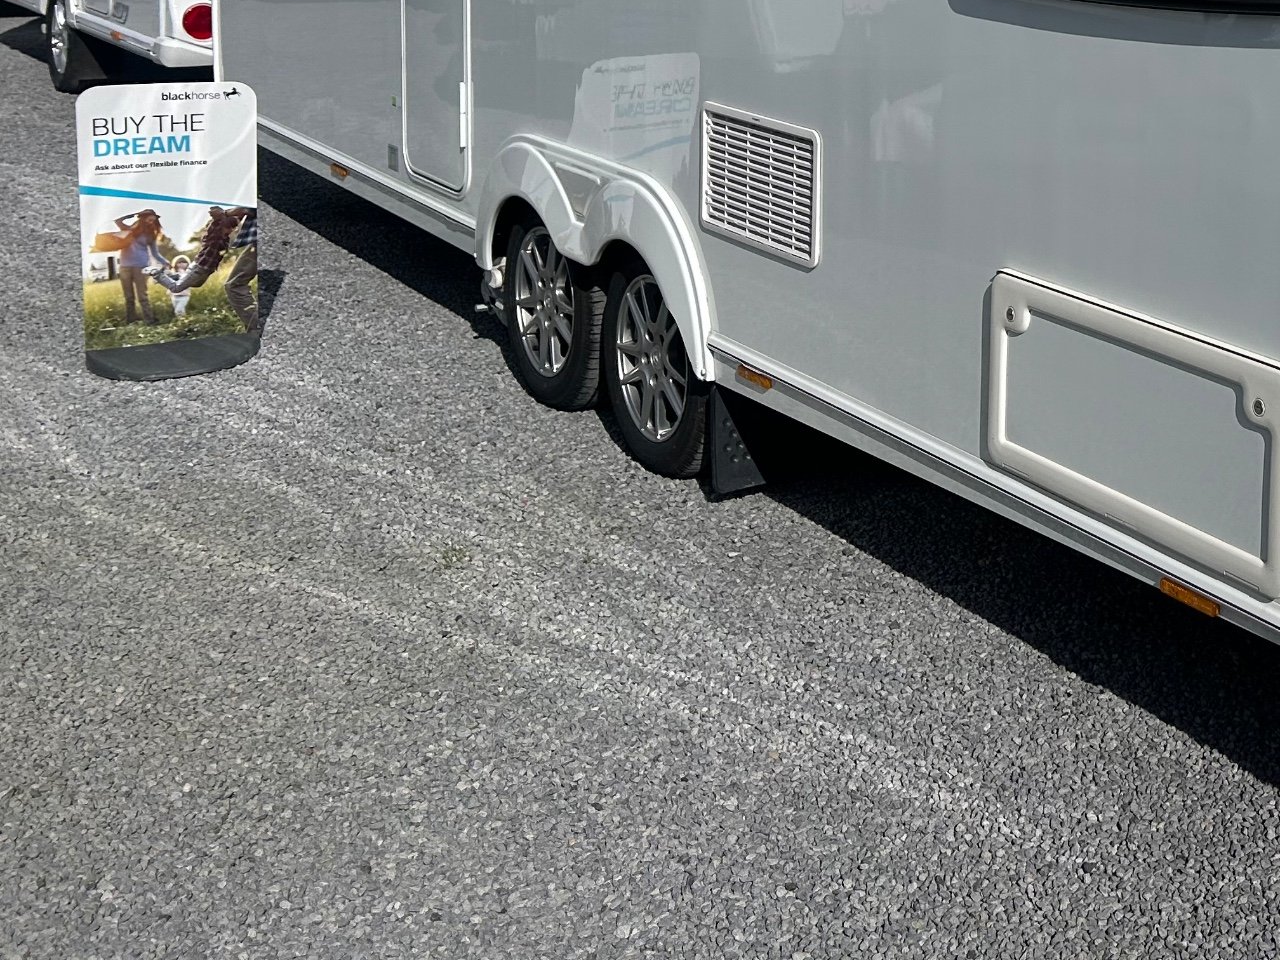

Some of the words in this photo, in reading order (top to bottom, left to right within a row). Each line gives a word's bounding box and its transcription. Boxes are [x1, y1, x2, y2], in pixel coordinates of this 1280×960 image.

[161, 91, 221, 101] blackhorse
[92, 115, 146, 137] BUY
[152, 113, 205, 133] THE
[93, 134, 191, 158] DREAM
[149, 160, 178, 168] flexible
